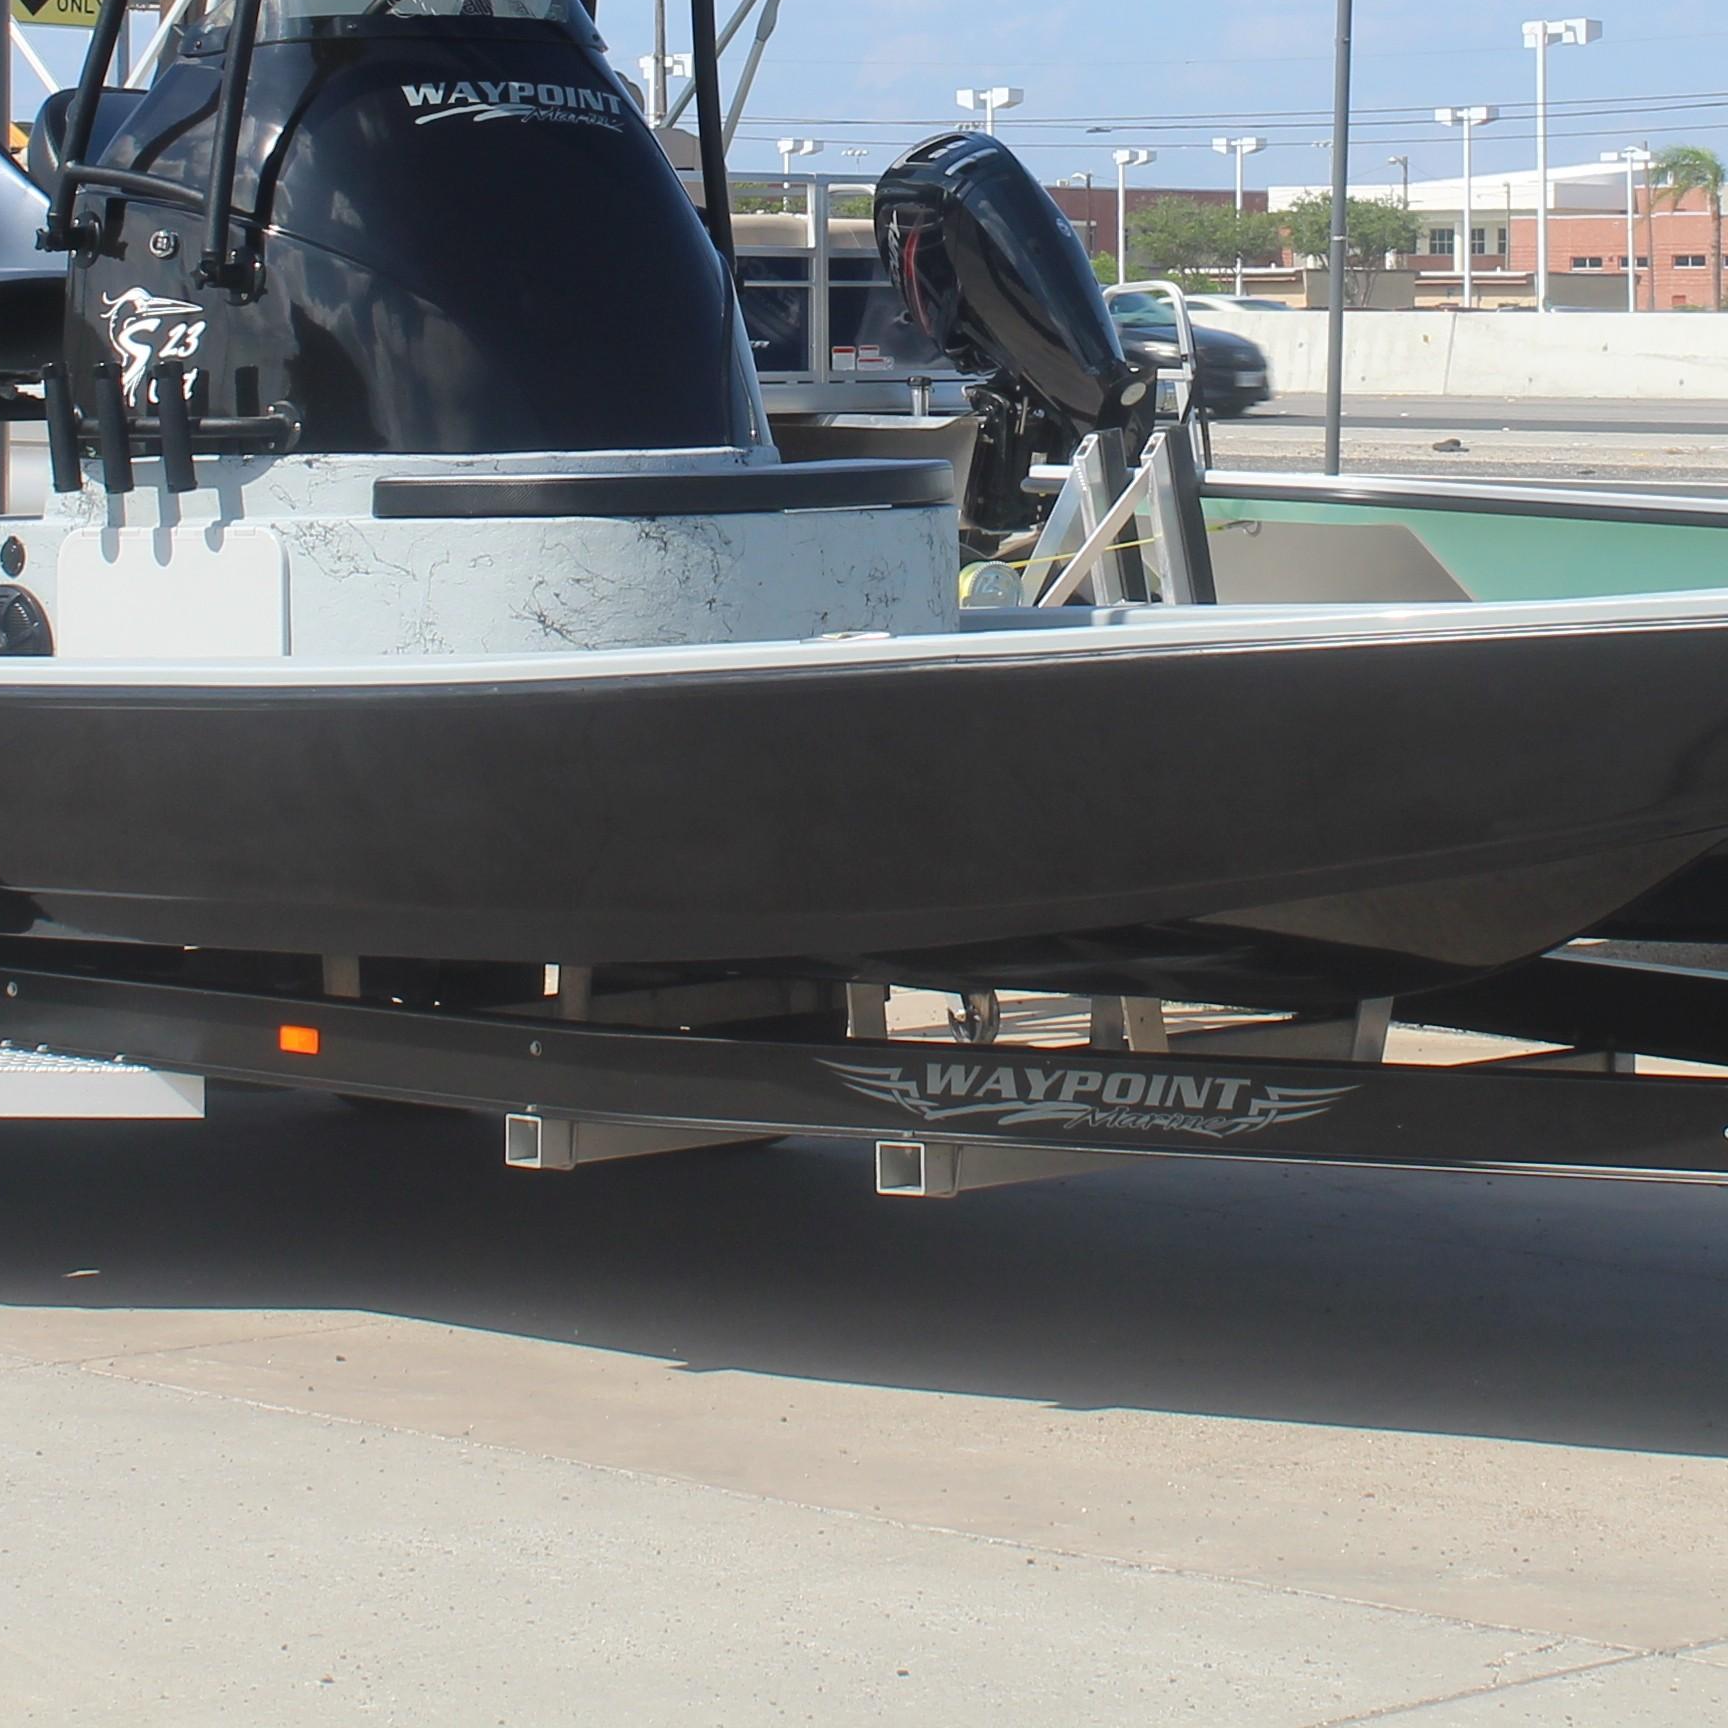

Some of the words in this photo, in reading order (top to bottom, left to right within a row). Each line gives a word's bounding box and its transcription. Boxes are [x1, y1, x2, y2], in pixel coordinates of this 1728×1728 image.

[400, 80, 623, 115] WAYPOINT
[158, 320, 207, 358] 23
[922, 1062, 1252, 1111] WAYPOINT
[1064, 1107, 1230, 1134] Marine
